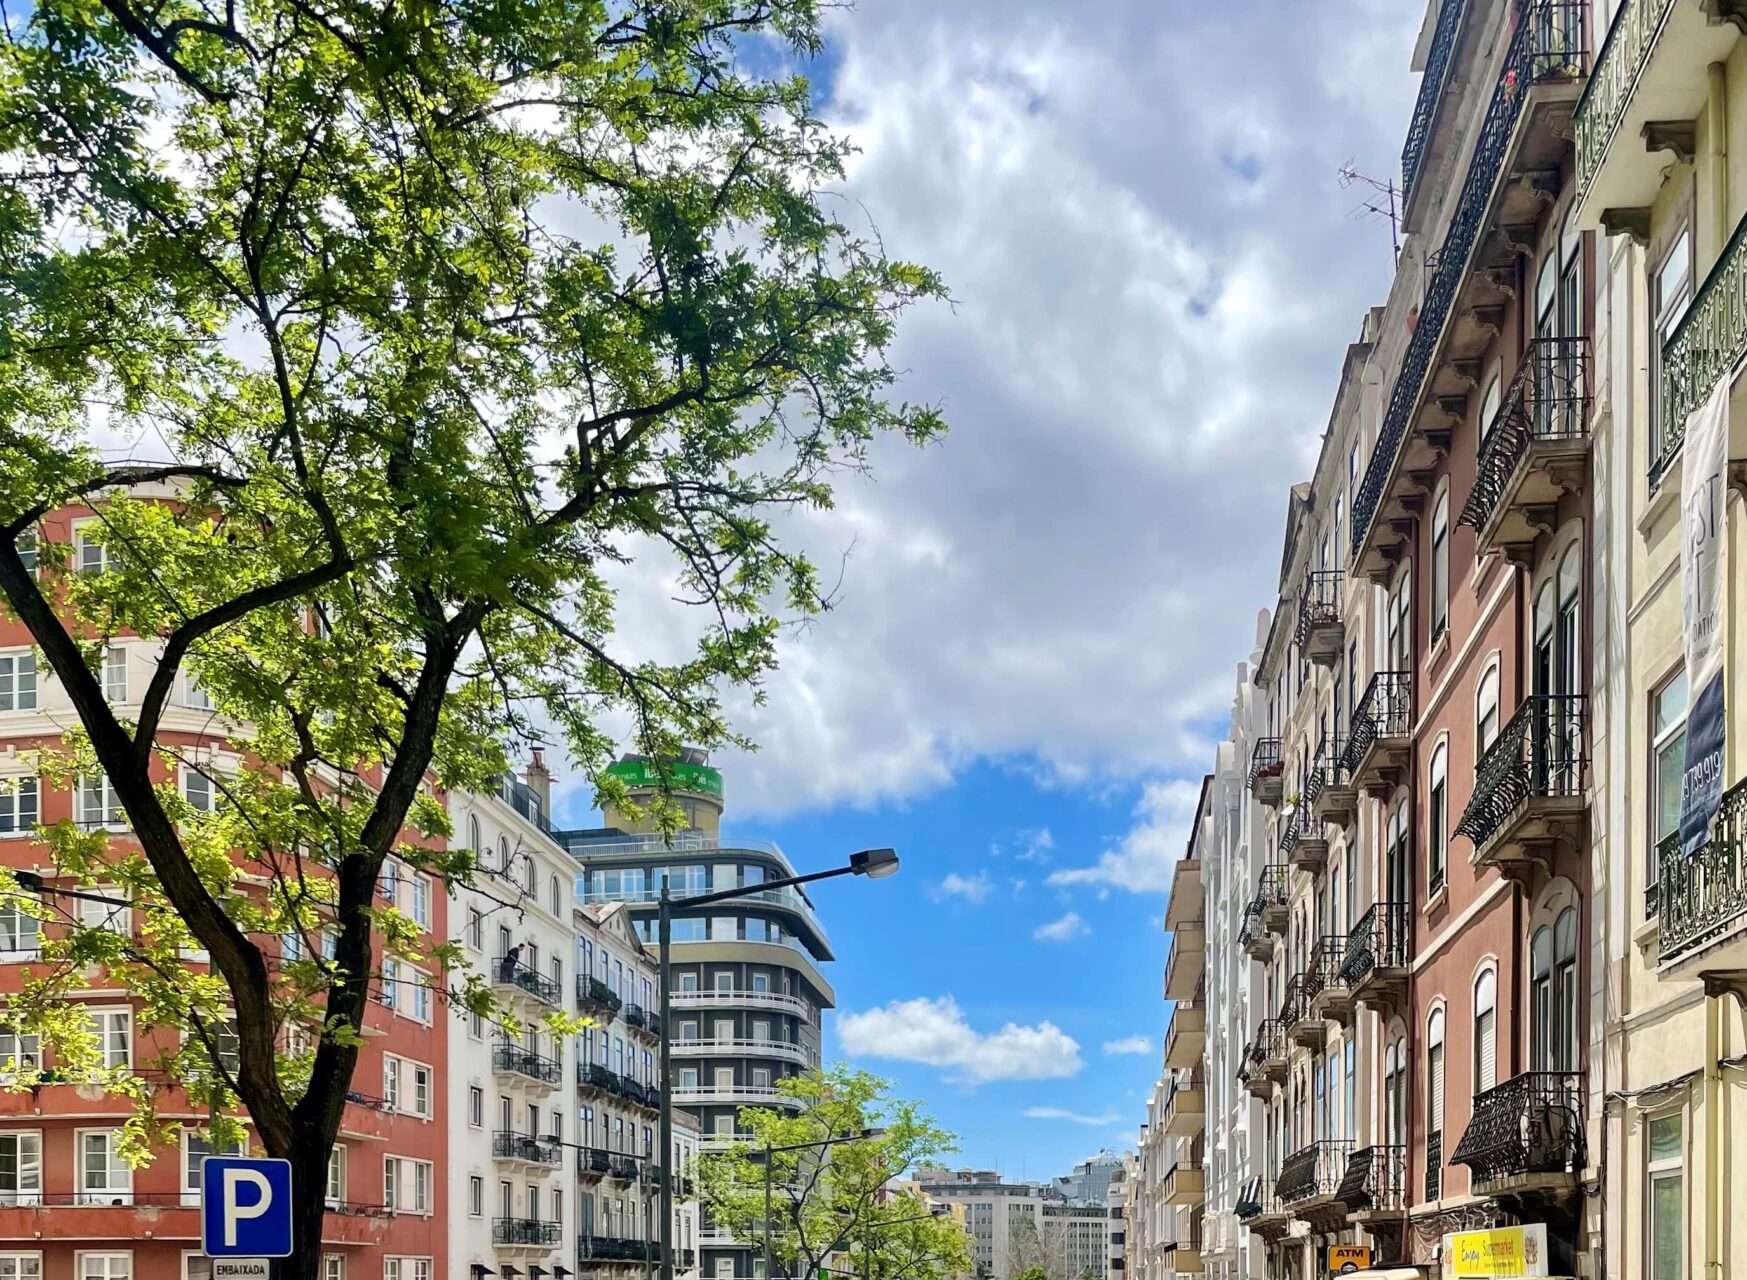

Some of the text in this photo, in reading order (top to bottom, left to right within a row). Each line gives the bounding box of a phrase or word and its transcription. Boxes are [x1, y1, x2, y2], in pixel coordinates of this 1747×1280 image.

[223, 1168, 273, 1247] P
[1336, 1249, 1364, 1258] ATM
[1461, 1239, 1480, 1270] Enjoy
[216, 1265, 266, 1276] EMBAIXADA
